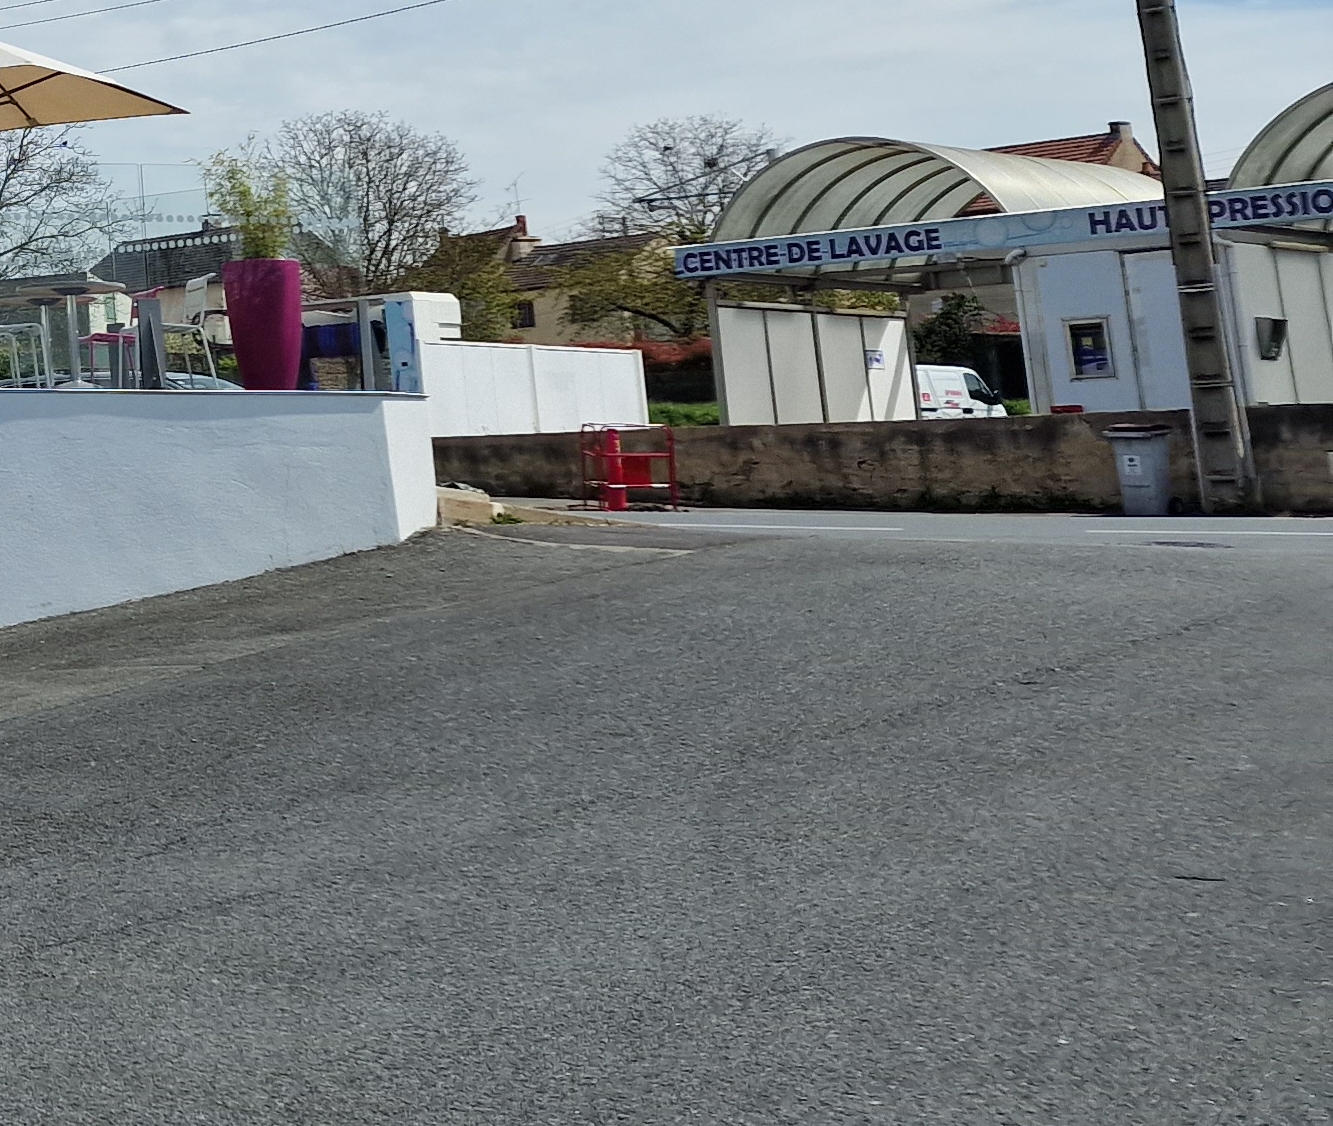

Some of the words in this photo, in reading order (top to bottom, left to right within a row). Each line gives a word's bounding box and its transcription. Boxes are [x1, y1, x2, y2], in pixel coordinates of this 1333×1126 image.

[683, 245, 780, 273] CENTRE
[787, 240, 822, 264] DE
[829, 228, 943, 259] LAVAGE
